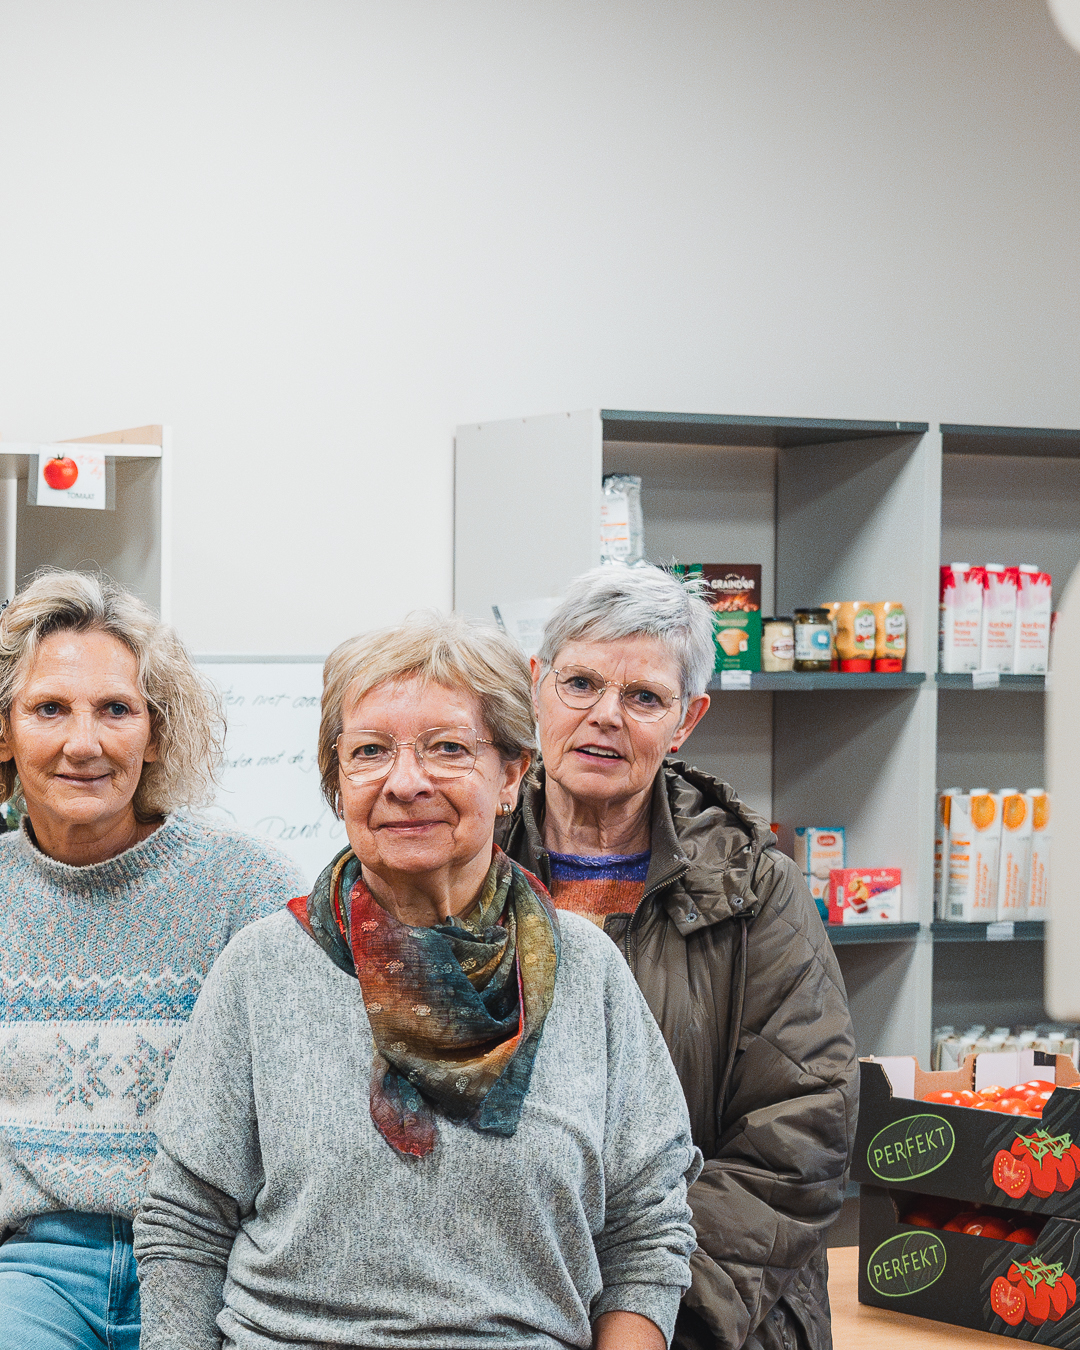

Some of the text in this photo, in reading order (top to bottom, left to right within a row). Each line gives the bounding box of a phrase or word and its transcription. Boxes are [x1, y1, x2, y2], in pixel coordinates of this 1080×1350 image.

[67, 491, 95, 500] TOMAAT
[254, 808, 328, 842] Dank
[873, 1126, 946, 1168] PERFEKT
[873, 1244, 939, 1284] PERFEKT
